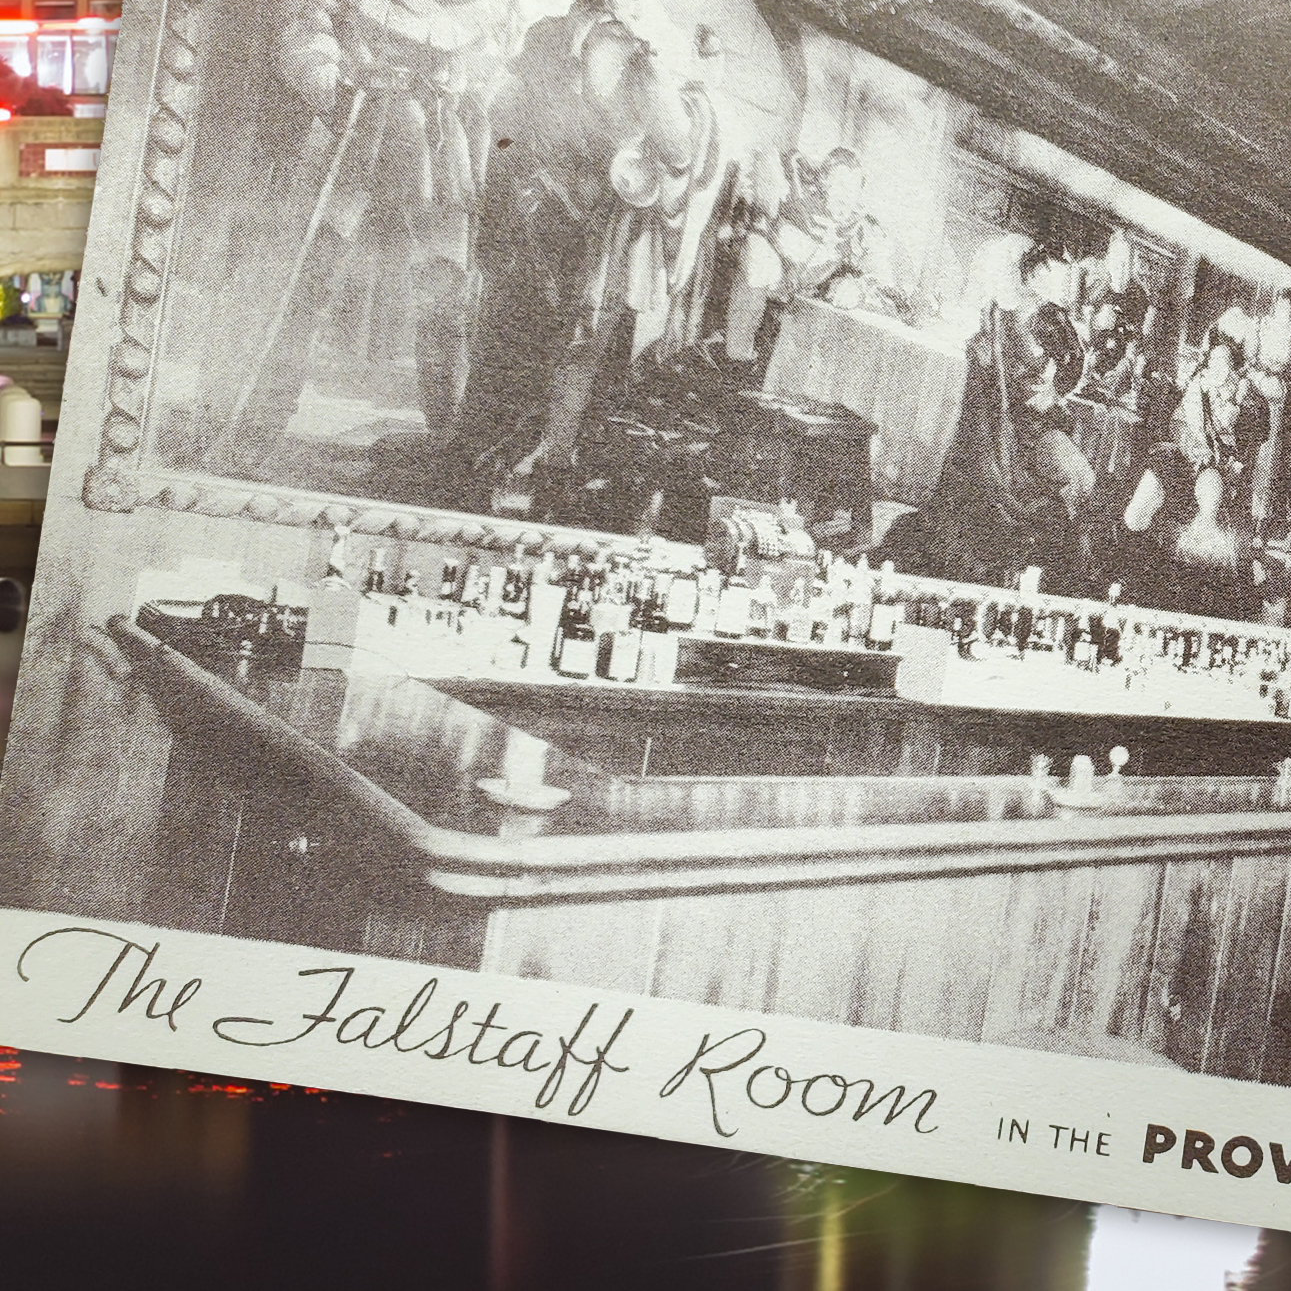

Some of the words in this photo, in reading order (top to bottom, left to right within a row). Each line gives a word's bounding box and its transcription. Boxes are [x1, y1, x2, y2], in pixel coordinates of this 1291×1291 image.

[16, 926, 202, 1033] The
[212, 966, 634, 1118] Falstaff
[659, 1027, 940, 1139] Room
[996, 1115, 1030, 1145] IN
[1048, 1123, 1112, 1158] THE
